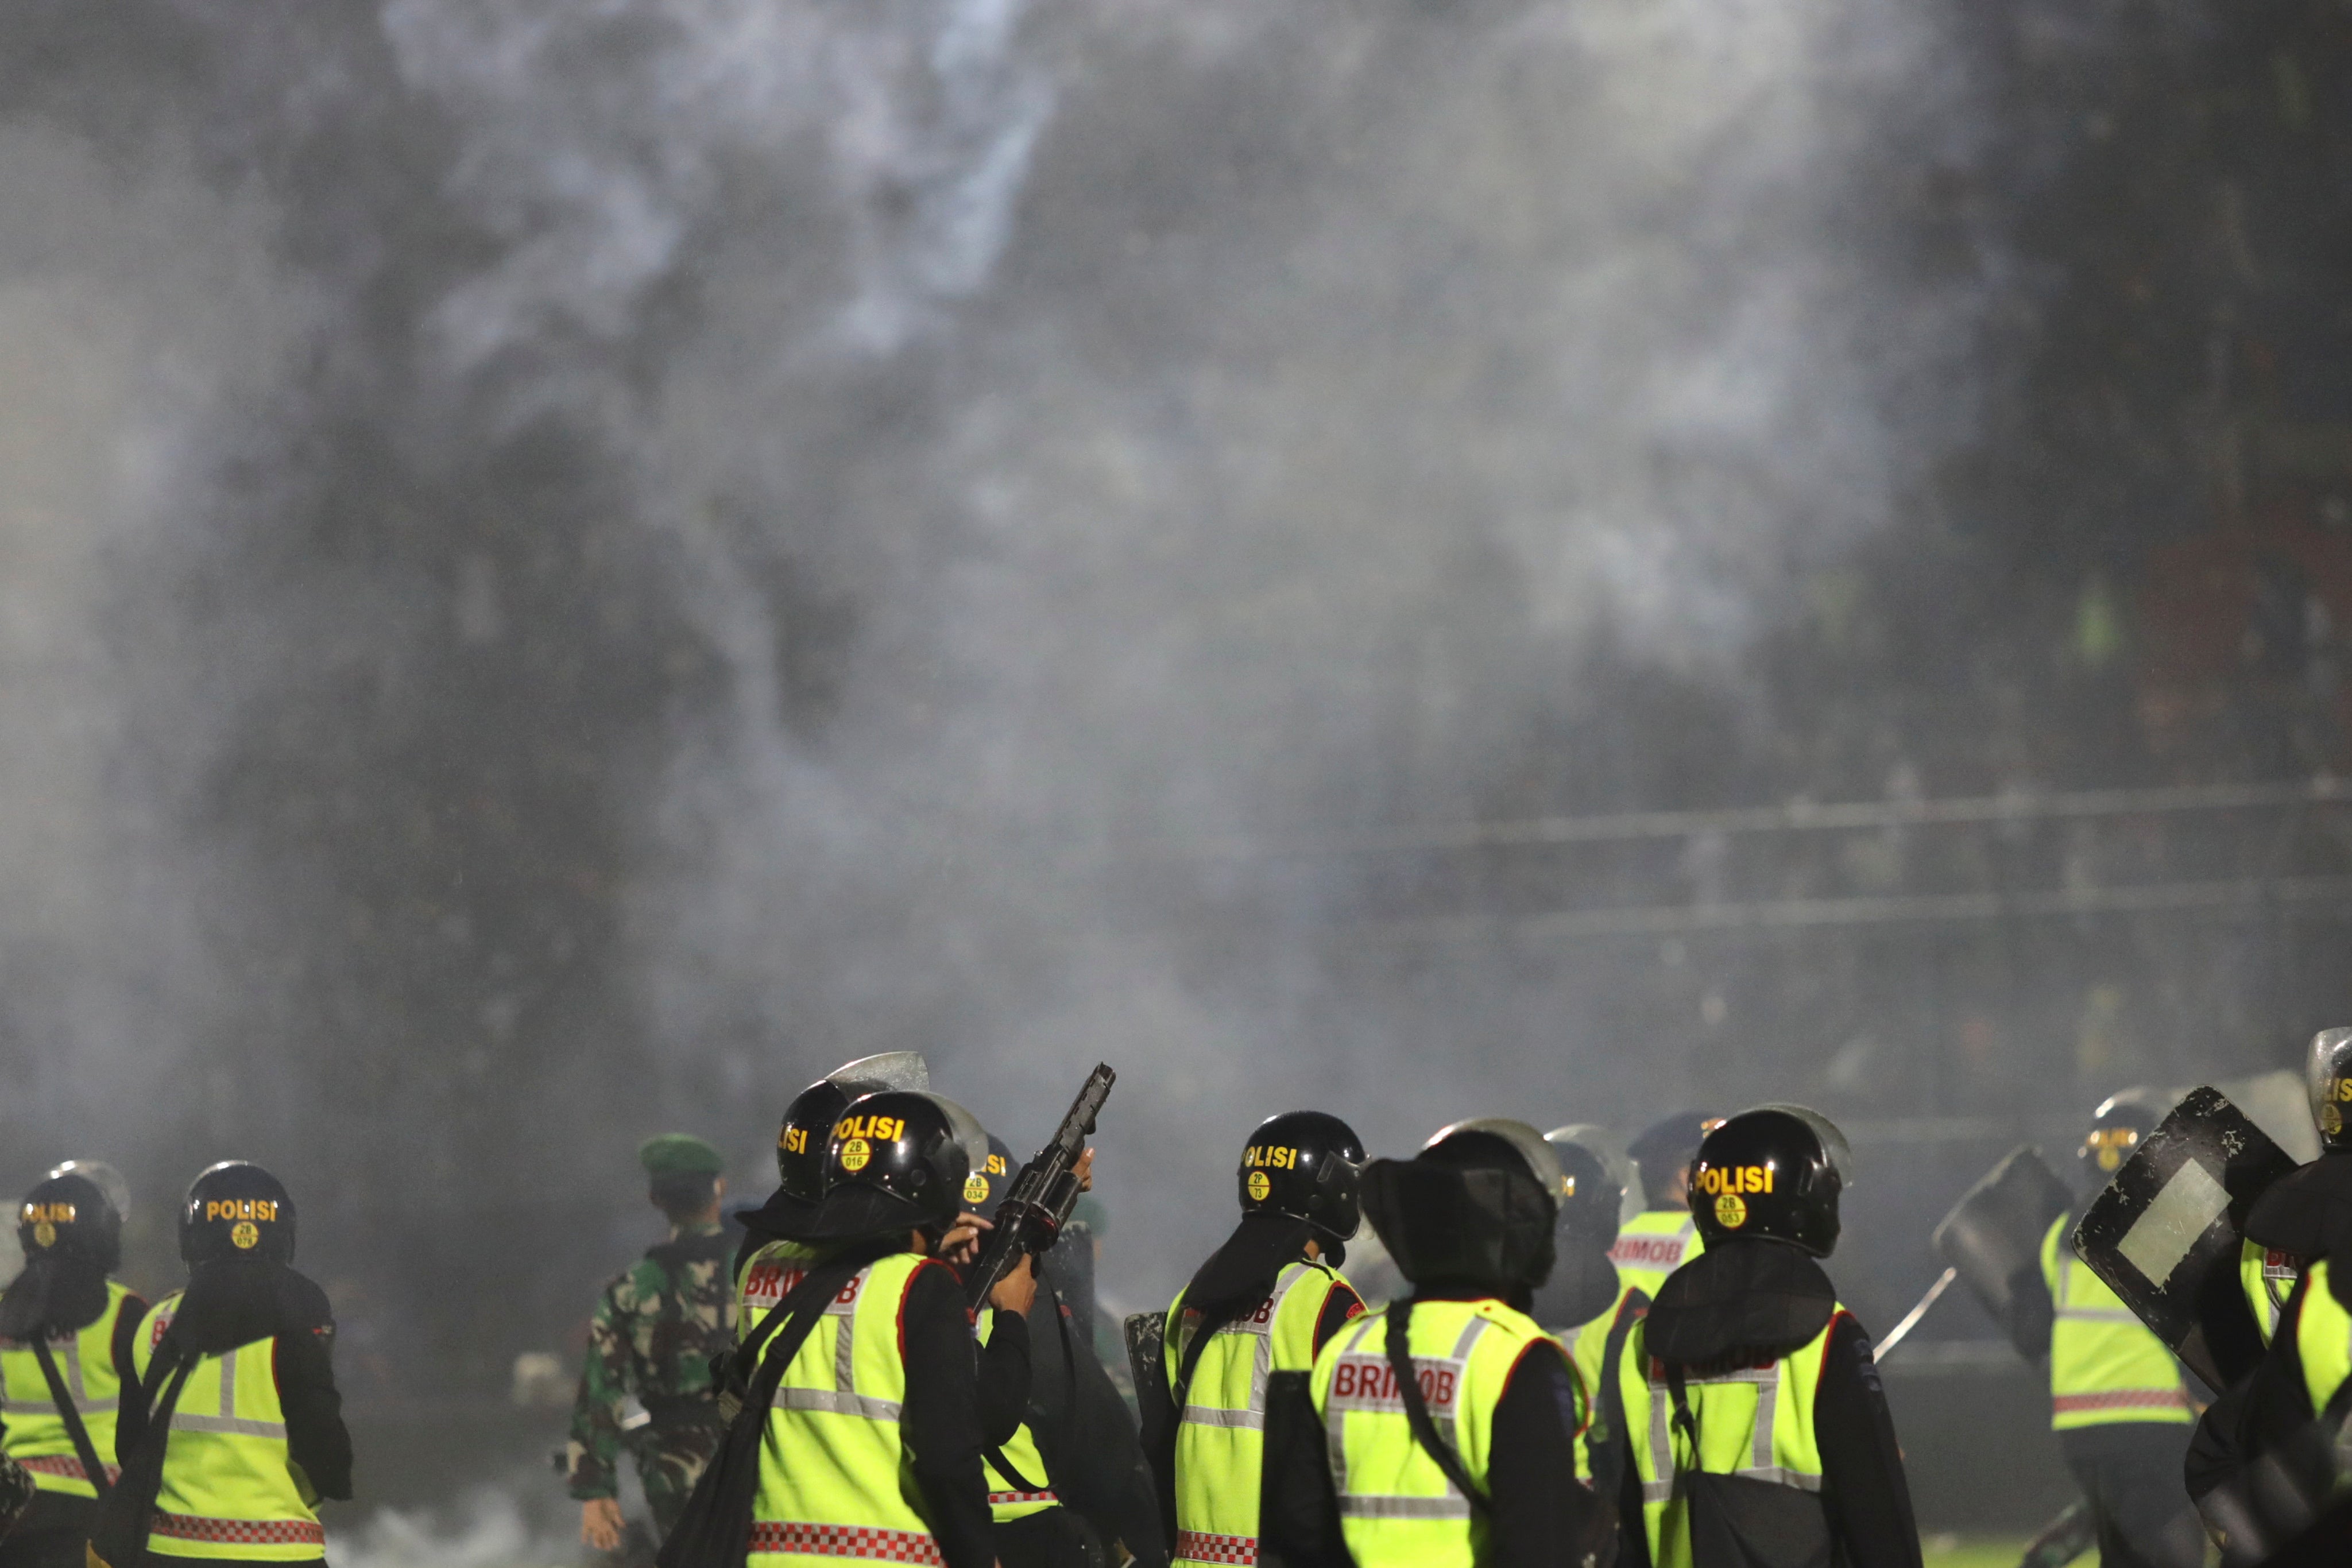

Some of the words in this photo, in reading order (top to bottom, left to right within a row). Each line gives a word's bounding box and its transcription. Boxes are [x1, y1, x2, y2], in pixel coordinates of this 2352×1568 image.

[832, 1116, 904, 1143] POLISI
[849, 1141, 862, 1153] 2B
[845, 1156, 862, 1167] 016
[1241, 1145, 1297, 1170] OLISI
[969, 1177, 982, 1187] 2B
[1254, 1173, 1263, 1184] 2P
[1696, 1166, 1773, 1195] POLISI
[966, 1190, 983, 1199] 034
[1254, 1188, 1262, 1198] 73
[207, 1199, 277, 1222] POLISI
[744, 1265, 861, 1304] BRIB
